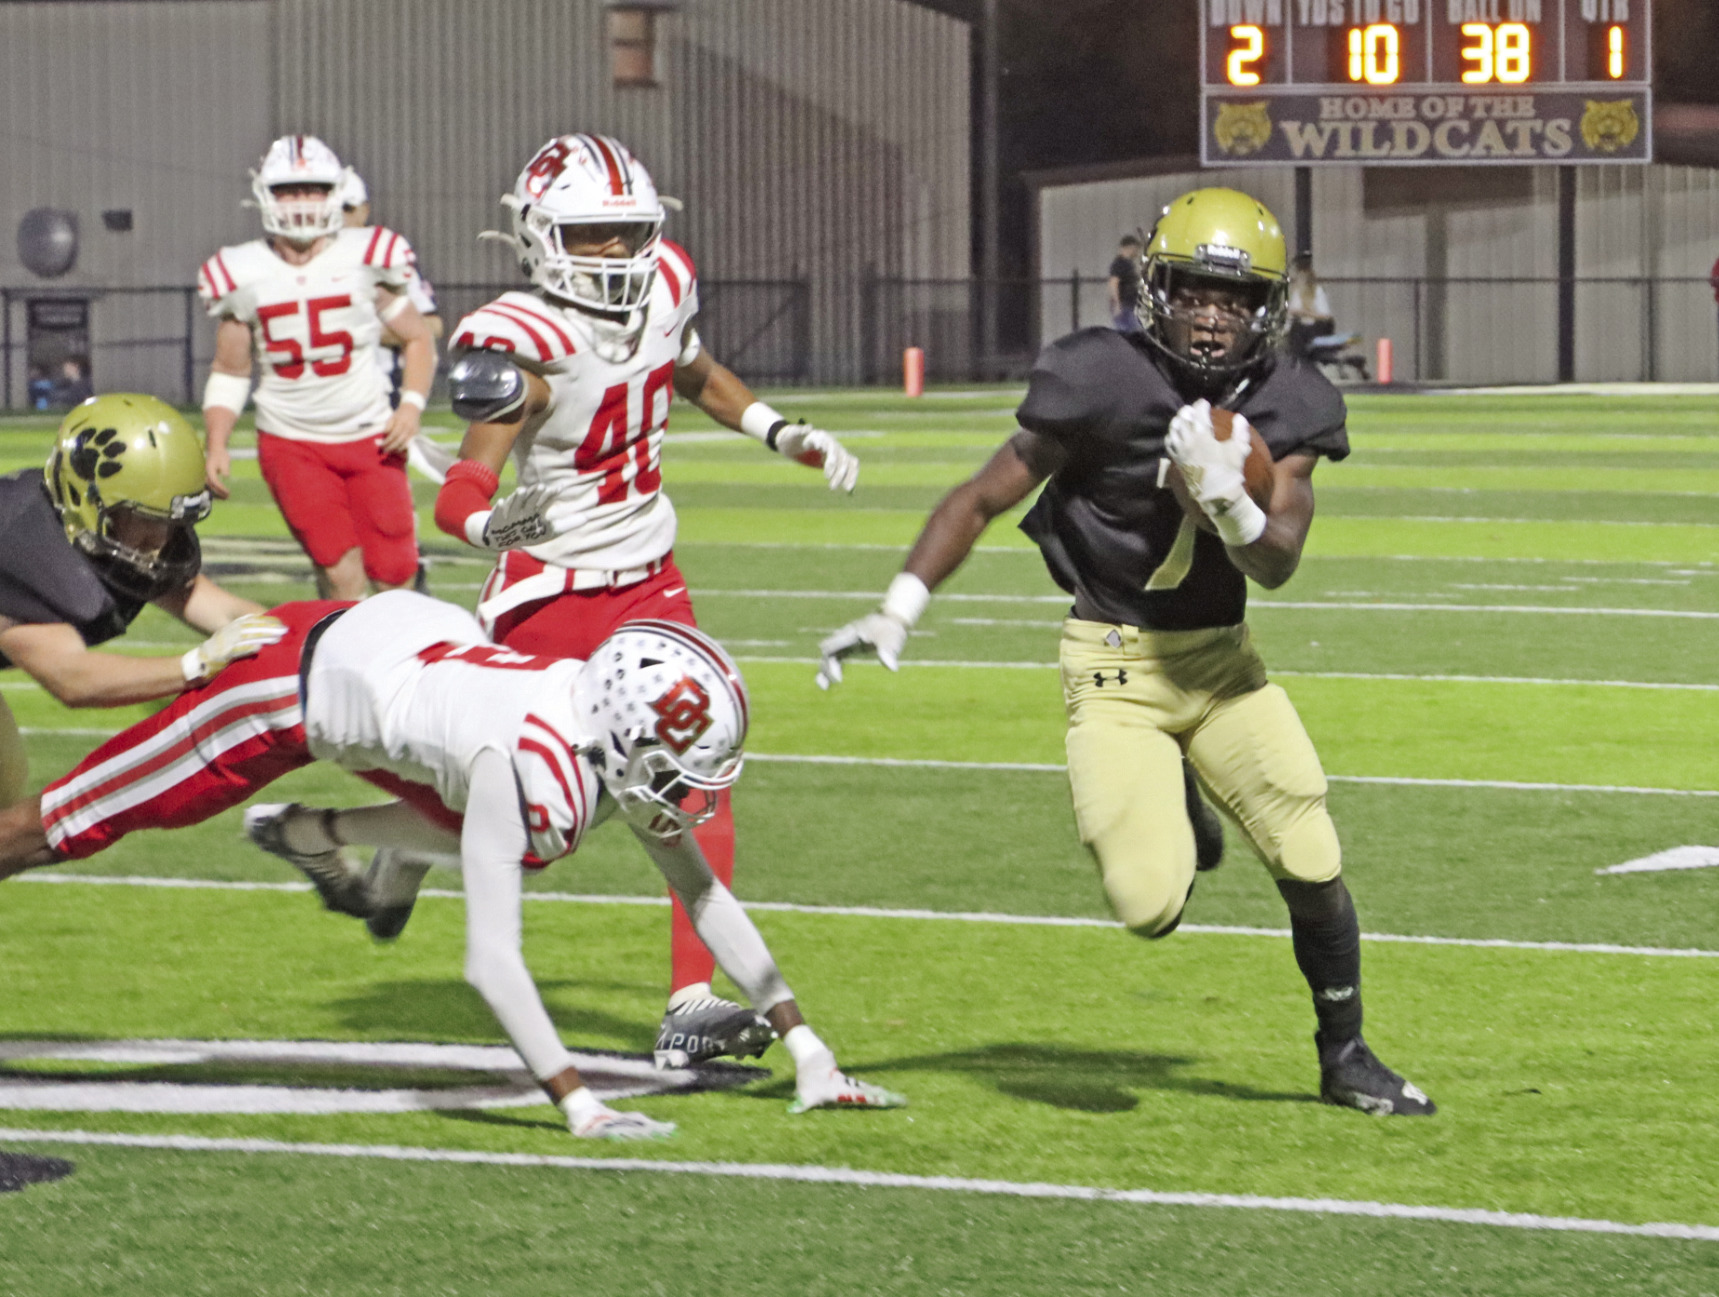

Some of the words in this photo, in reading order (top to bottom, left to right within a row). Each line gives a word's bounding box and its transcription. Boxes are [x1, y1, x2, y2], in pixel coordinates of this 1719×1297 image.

[1227, 24, 1264, 86] 2
[1348, 24, 1400, 85] 10
[1461, 23, 1531, 84] 38
[1608, 26, 1624, 79] 1
[1279, 118, 1573, 157] WILDCATS
[1319, 96, 1416, 120] HOME
[1420, 96, 1466, 120] OF
[1470, 96, 1536, 119] THE
[257, 294, 353, 380] 55
[575, 360, 674, 503] 40
